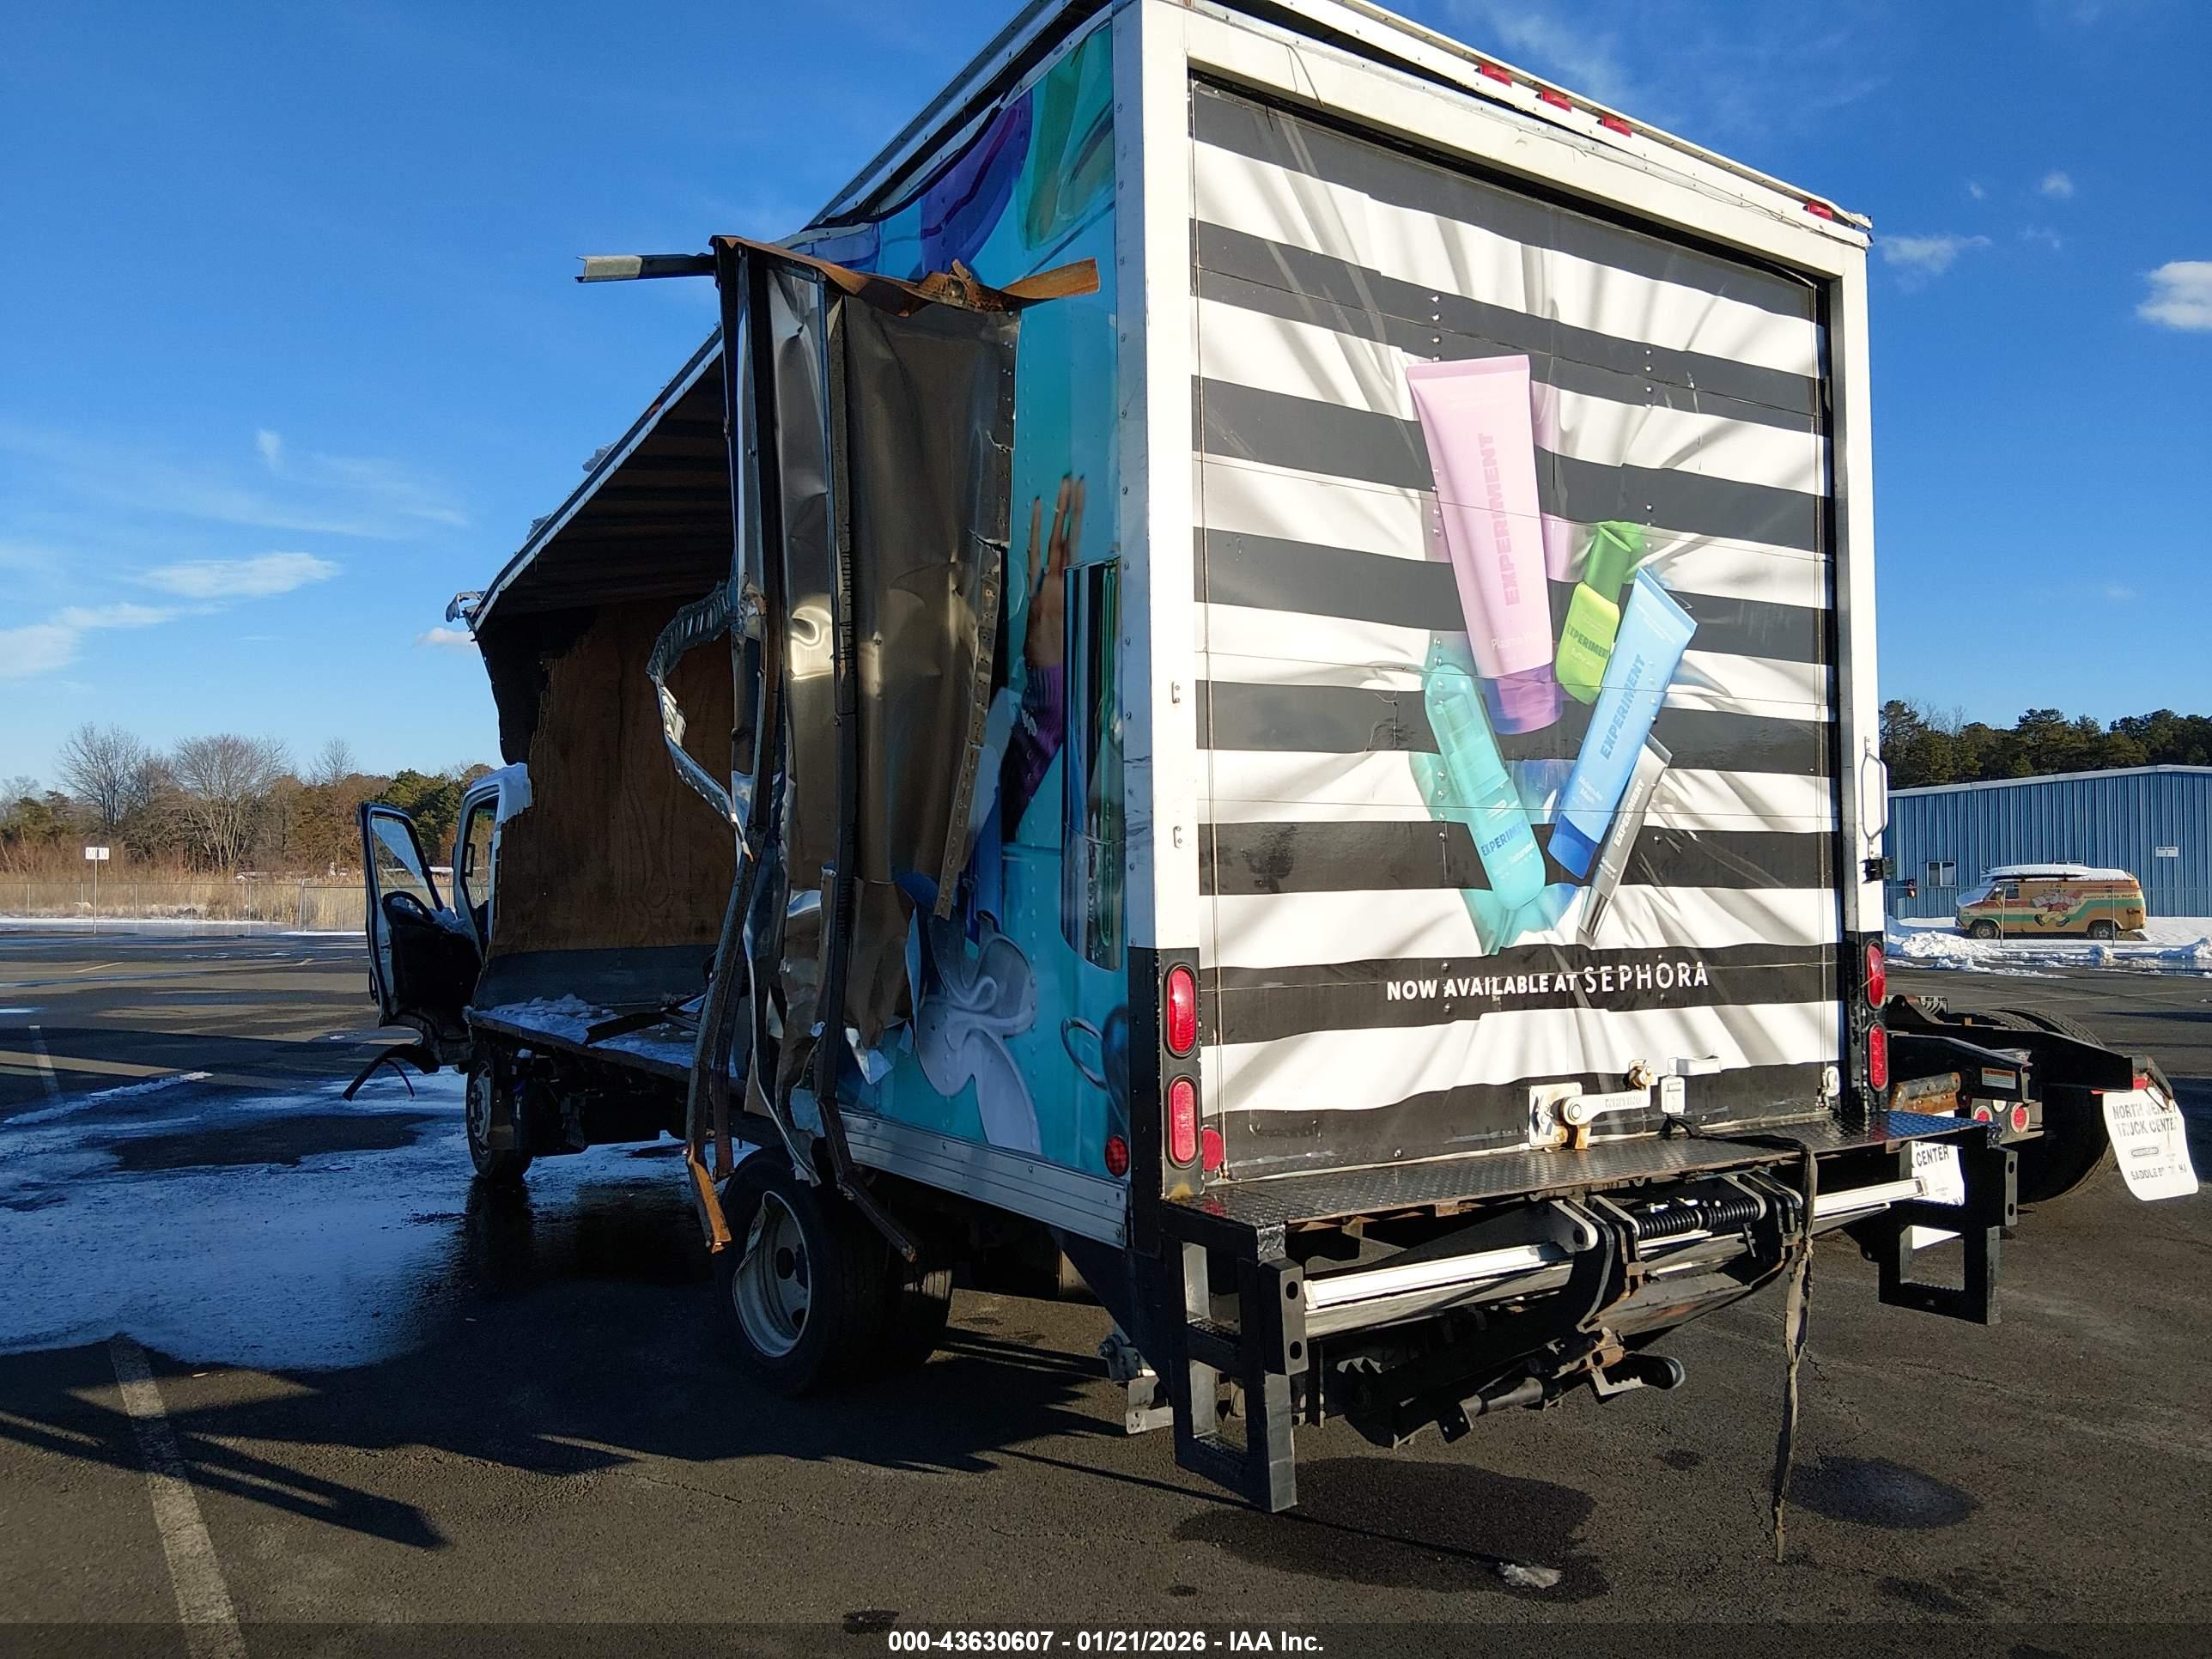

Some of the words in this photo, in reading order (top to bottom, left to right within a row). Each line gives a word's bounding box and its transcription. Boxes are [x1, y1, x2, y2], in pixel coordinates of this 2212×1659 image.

[1478, 433, 1520, 607] EXPERIMENT
[1599, 653, 1646, 761] EXPERIMENT
[1613, 778, 1645, 848] EXPERIMENT
[1480, 817, 1528, 857] EXPERIME
[1386, 979, 1437, 1001] NOW
[1443, 974, 1549, 998] AVAILABLE
[1554, 973, 1577, 993] AT
[1583, 961, 1710, 994] SEPHORA
[2112, 1102, 2143, 1120] NORTH
[2148, 1116, 2179, 1133] CENTE
[1916, 1146, 1950, 1167] CENTER
